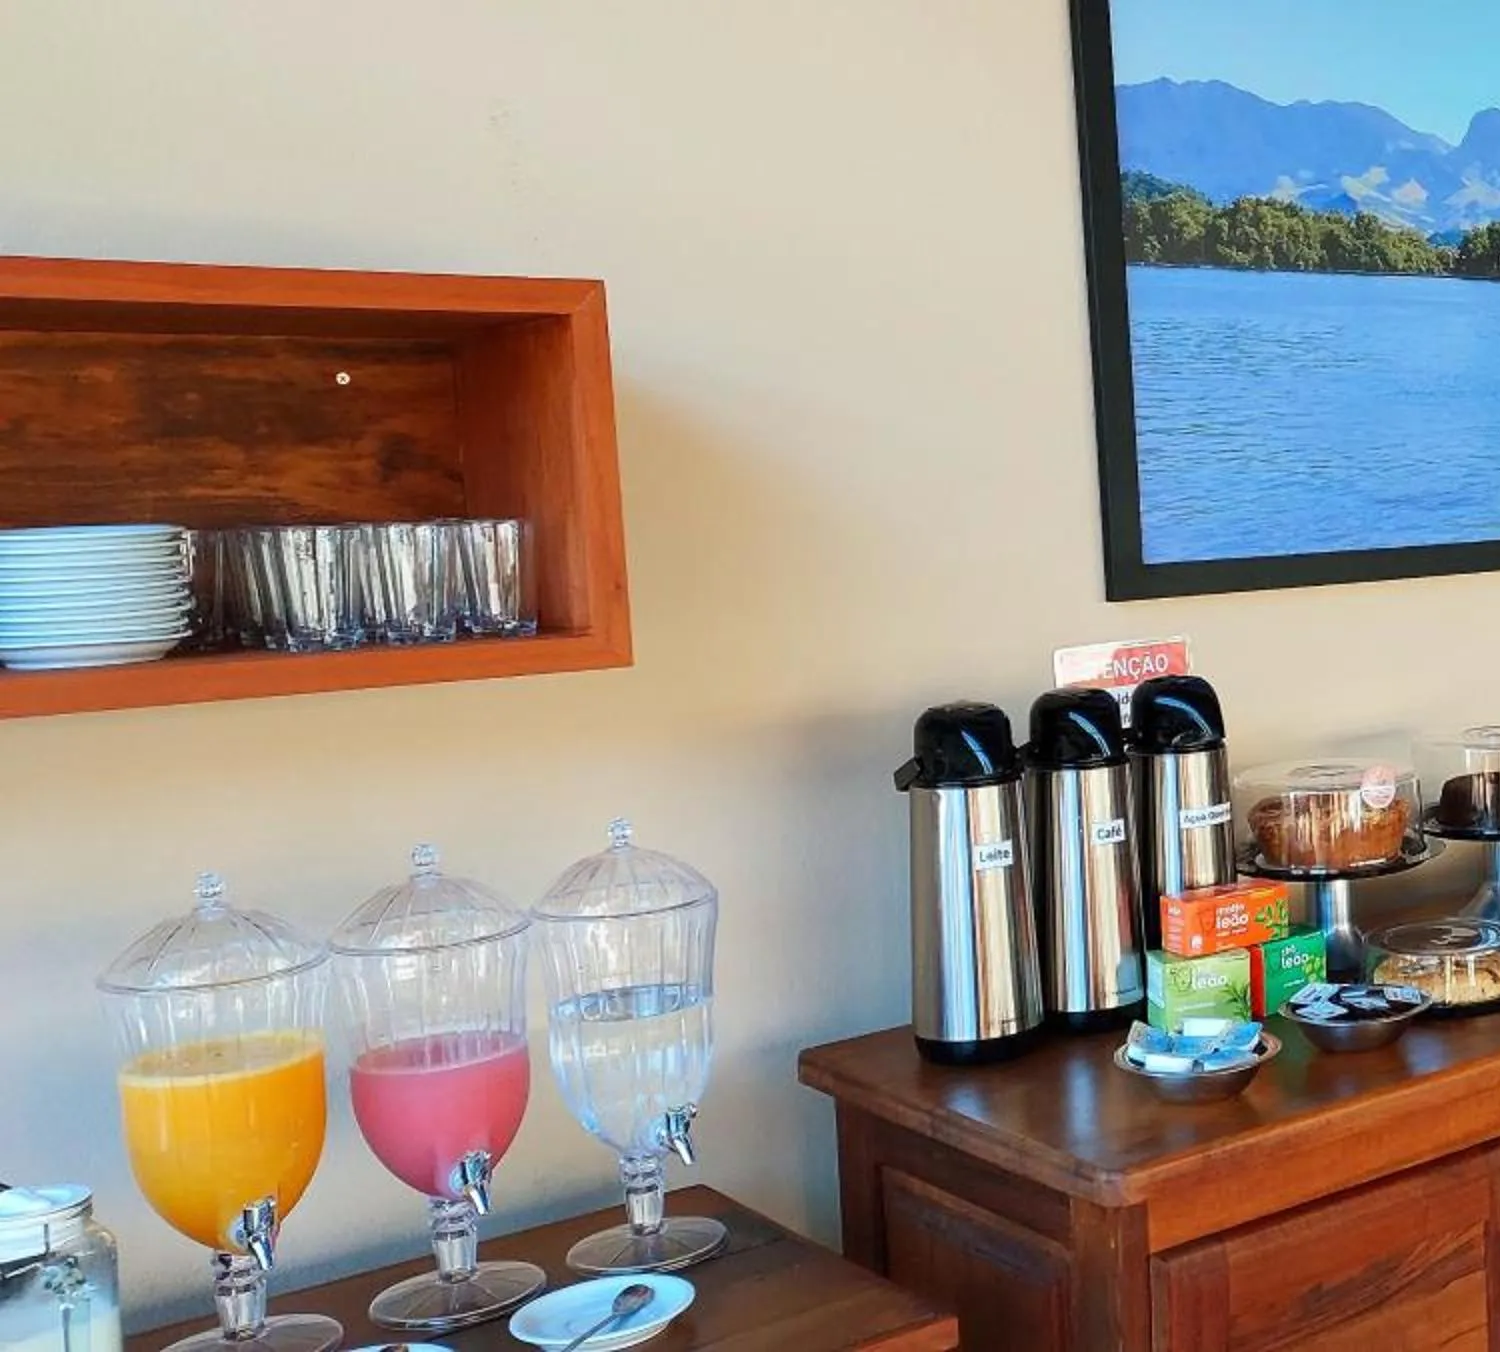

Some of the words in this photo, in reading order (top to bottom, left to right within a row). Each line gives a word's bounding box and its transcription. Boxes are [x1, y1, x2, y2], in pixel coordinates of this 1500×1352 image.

[1102, 651, 1169, 681] ENÇÃO
[1097, 823, 1123, 840] Café
[979, 847, 1011, 862] Leite
